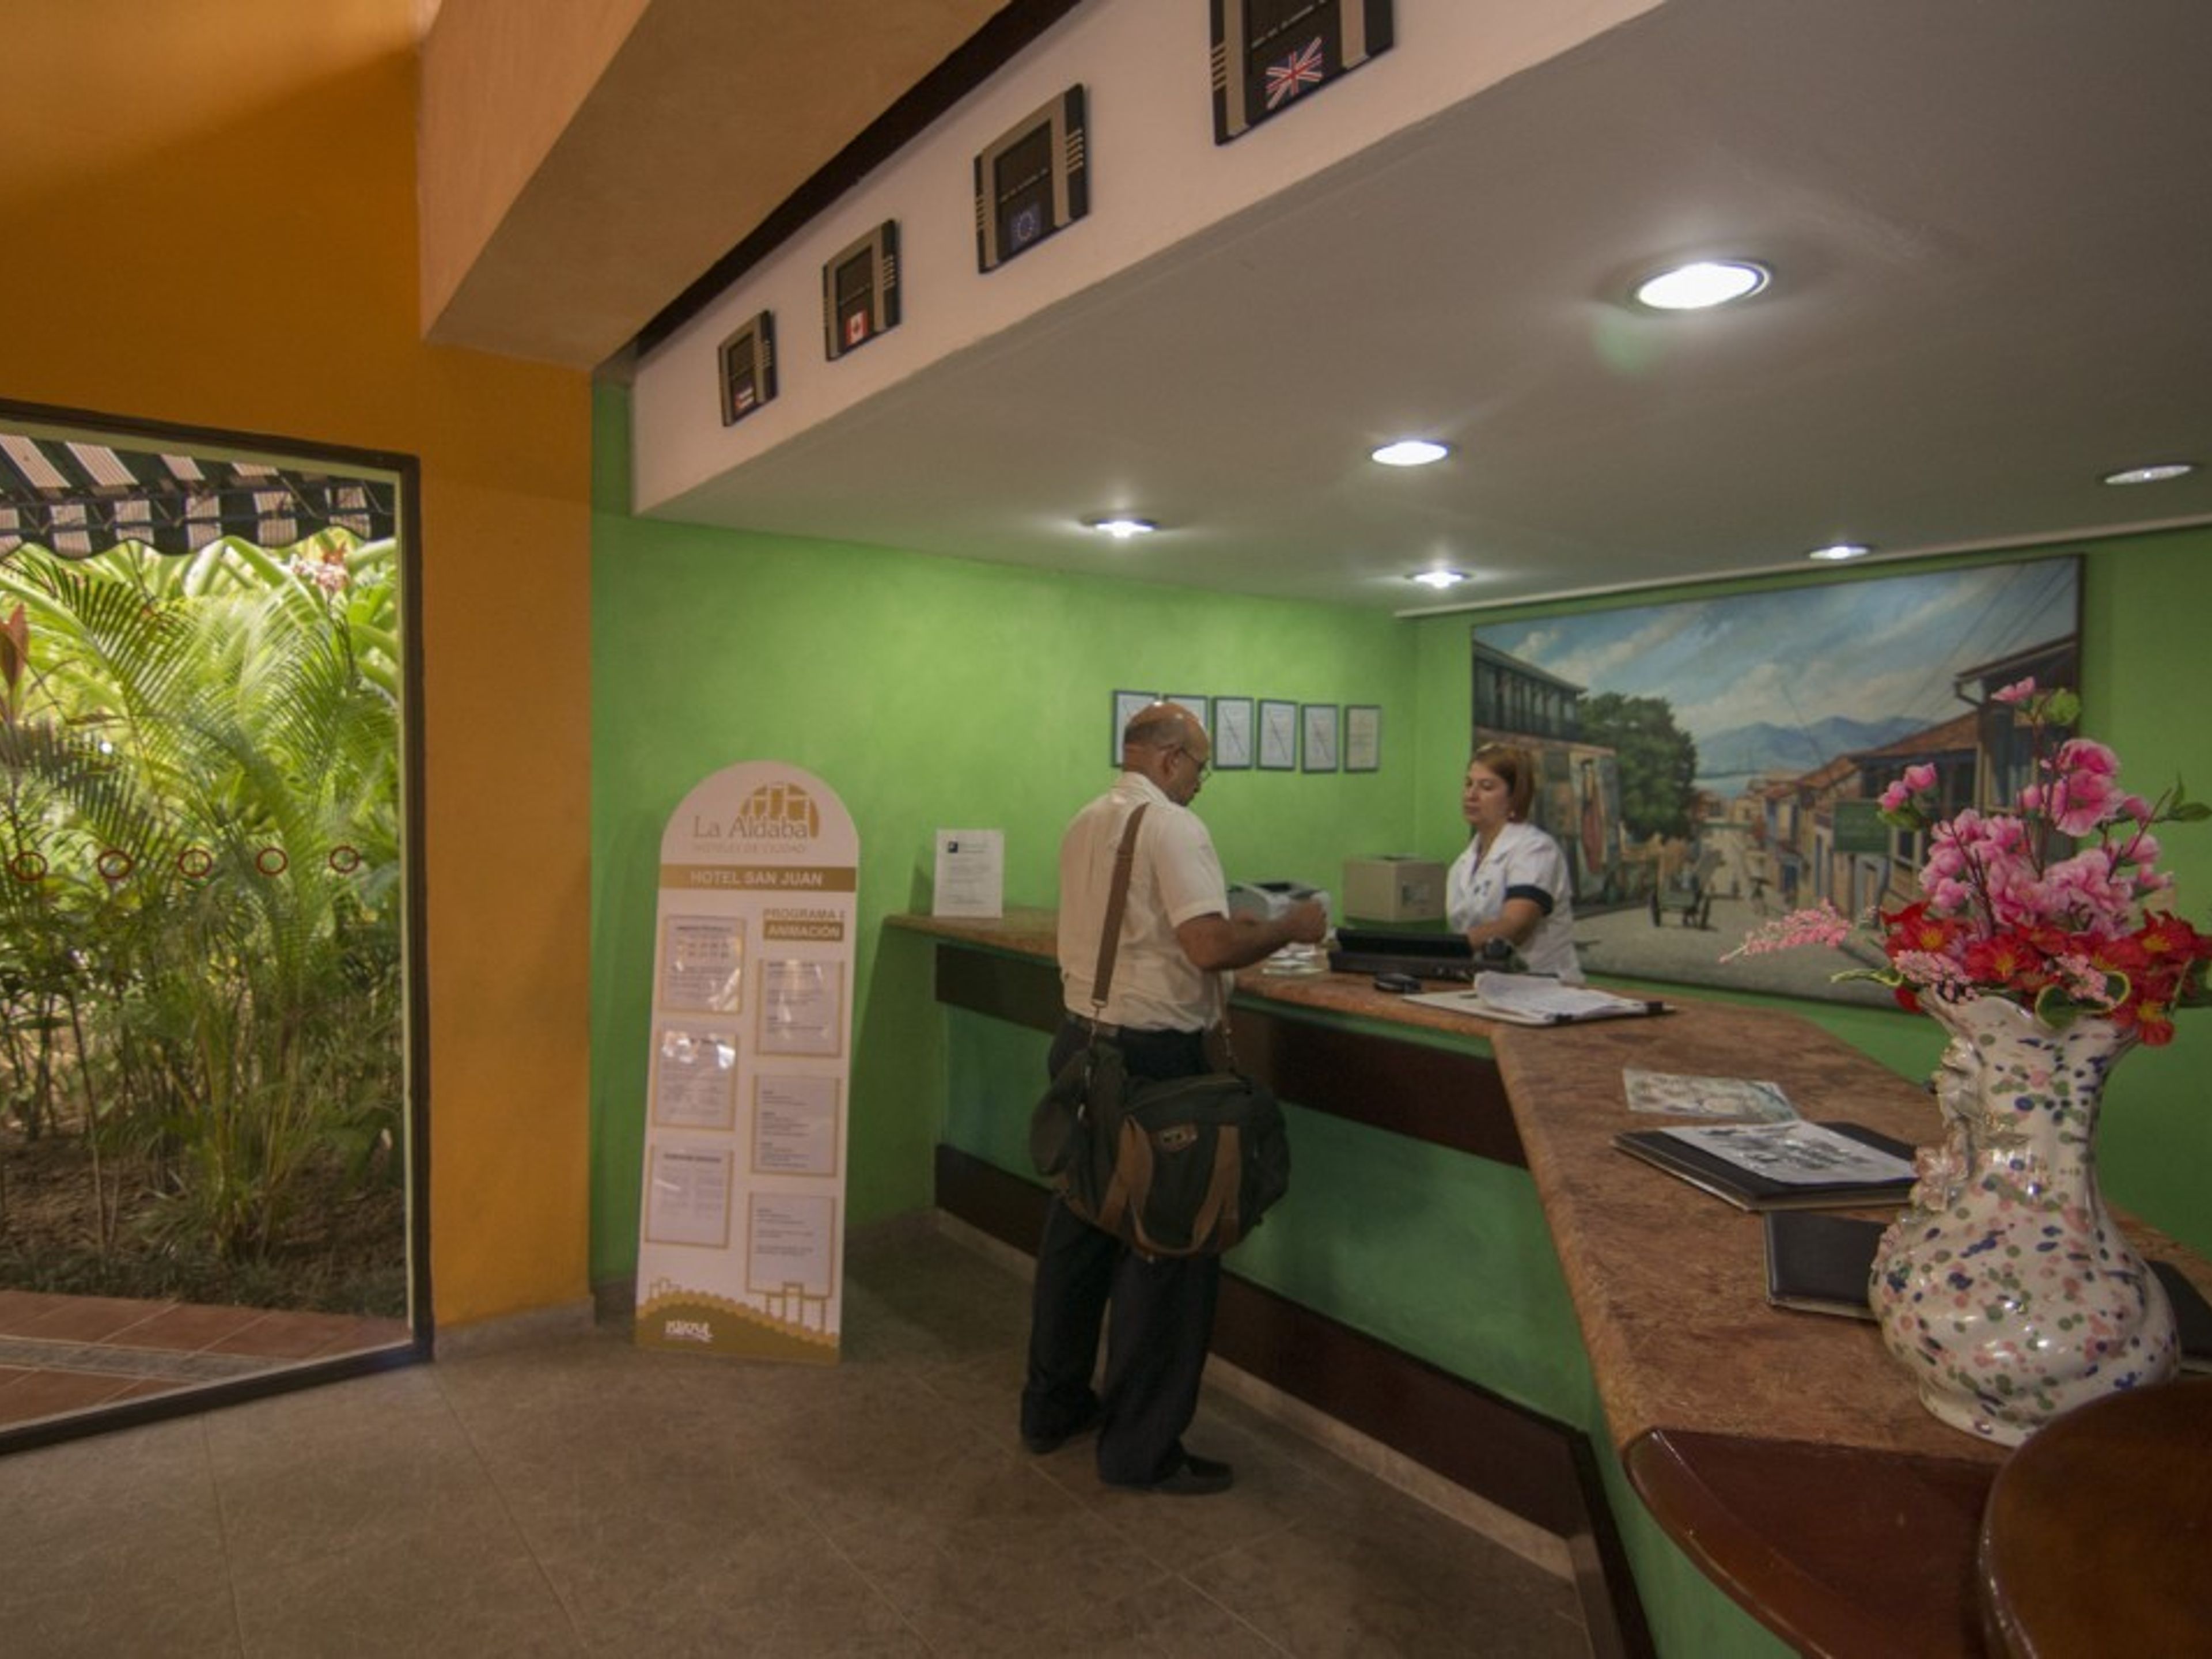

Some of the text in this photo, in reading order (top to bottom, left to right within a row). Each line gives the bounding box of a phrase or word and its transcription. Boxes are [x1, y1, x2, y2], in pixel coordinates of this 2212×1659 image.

[694, 815, 808, 838] La Aldaba
[691, 870, 824, 886] HOTEL SAN JUAN
[763, 908, 835, 918] PROGRAMA
